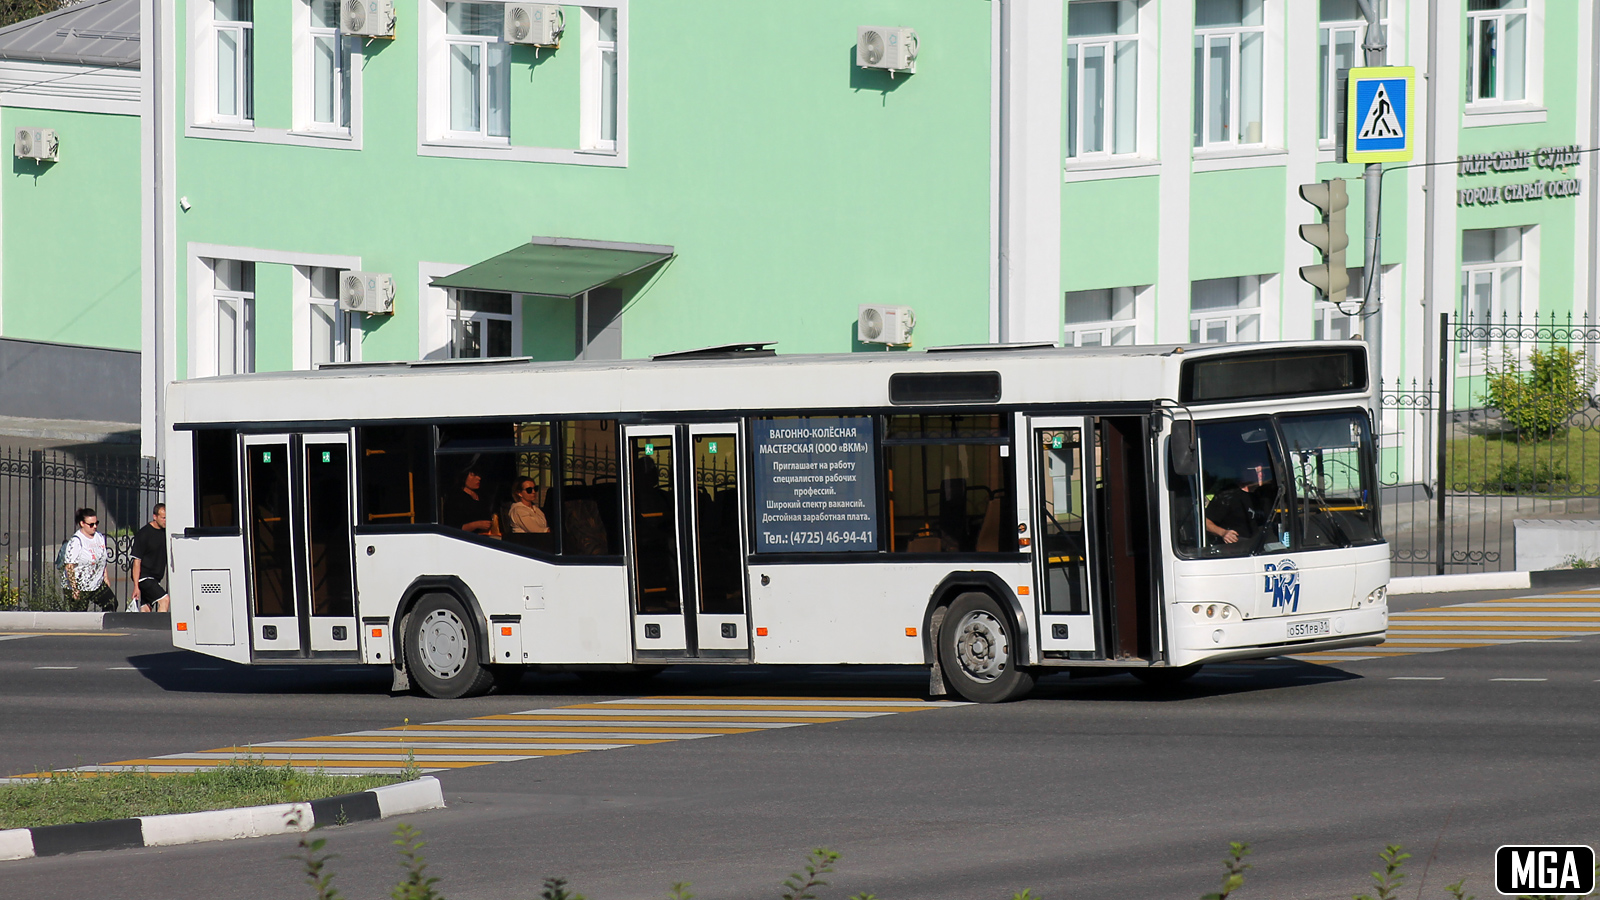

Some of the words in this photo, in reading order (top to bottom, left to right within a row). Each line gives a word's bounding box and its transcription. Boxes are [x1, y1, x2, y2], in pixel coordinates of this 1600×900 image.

[1457, 150, 1531, 175] МИРОВЫЕ
[1535, 145, 1581, 169] СУДЬИ
[1457, 187, 1500, 206] ГОРОДА
[1502, 180, 1545, 202] СТАРЫЙ
[1545, 179, 1581, 198] ОСКОЛ
[770, 426, 856, 439] ВАГОННО-КОЛЁСНАЯ
[760, 443, 814, 454] МАСТЕРСКАЯ
[815, 443, 837, 453] (ООО
[838, 443, 868, 453] «ВКМ»)
[773, 462, 817, 471] Приглашает
[830, 460, 855, 470] работу
[773, 475, 823, 484] специалистов
[825, 474, 856, 484] рабочих
[794, 487, 836, 497] профессий.
[766, 500, 800, 510] Широкий
[802, 501, 827, 509] спектр
[829, 499, 865, 508] вакансий.
[762, 513, 801, 523] Достойная
[803, 512, 845, 523] заработная
[763, 532, 788, 544] Тел.:
[790, 531, 823, 545] (4725)
[826, 531, 872, 543] 46-94-41
[1320, 621, 1327, 630] 31
